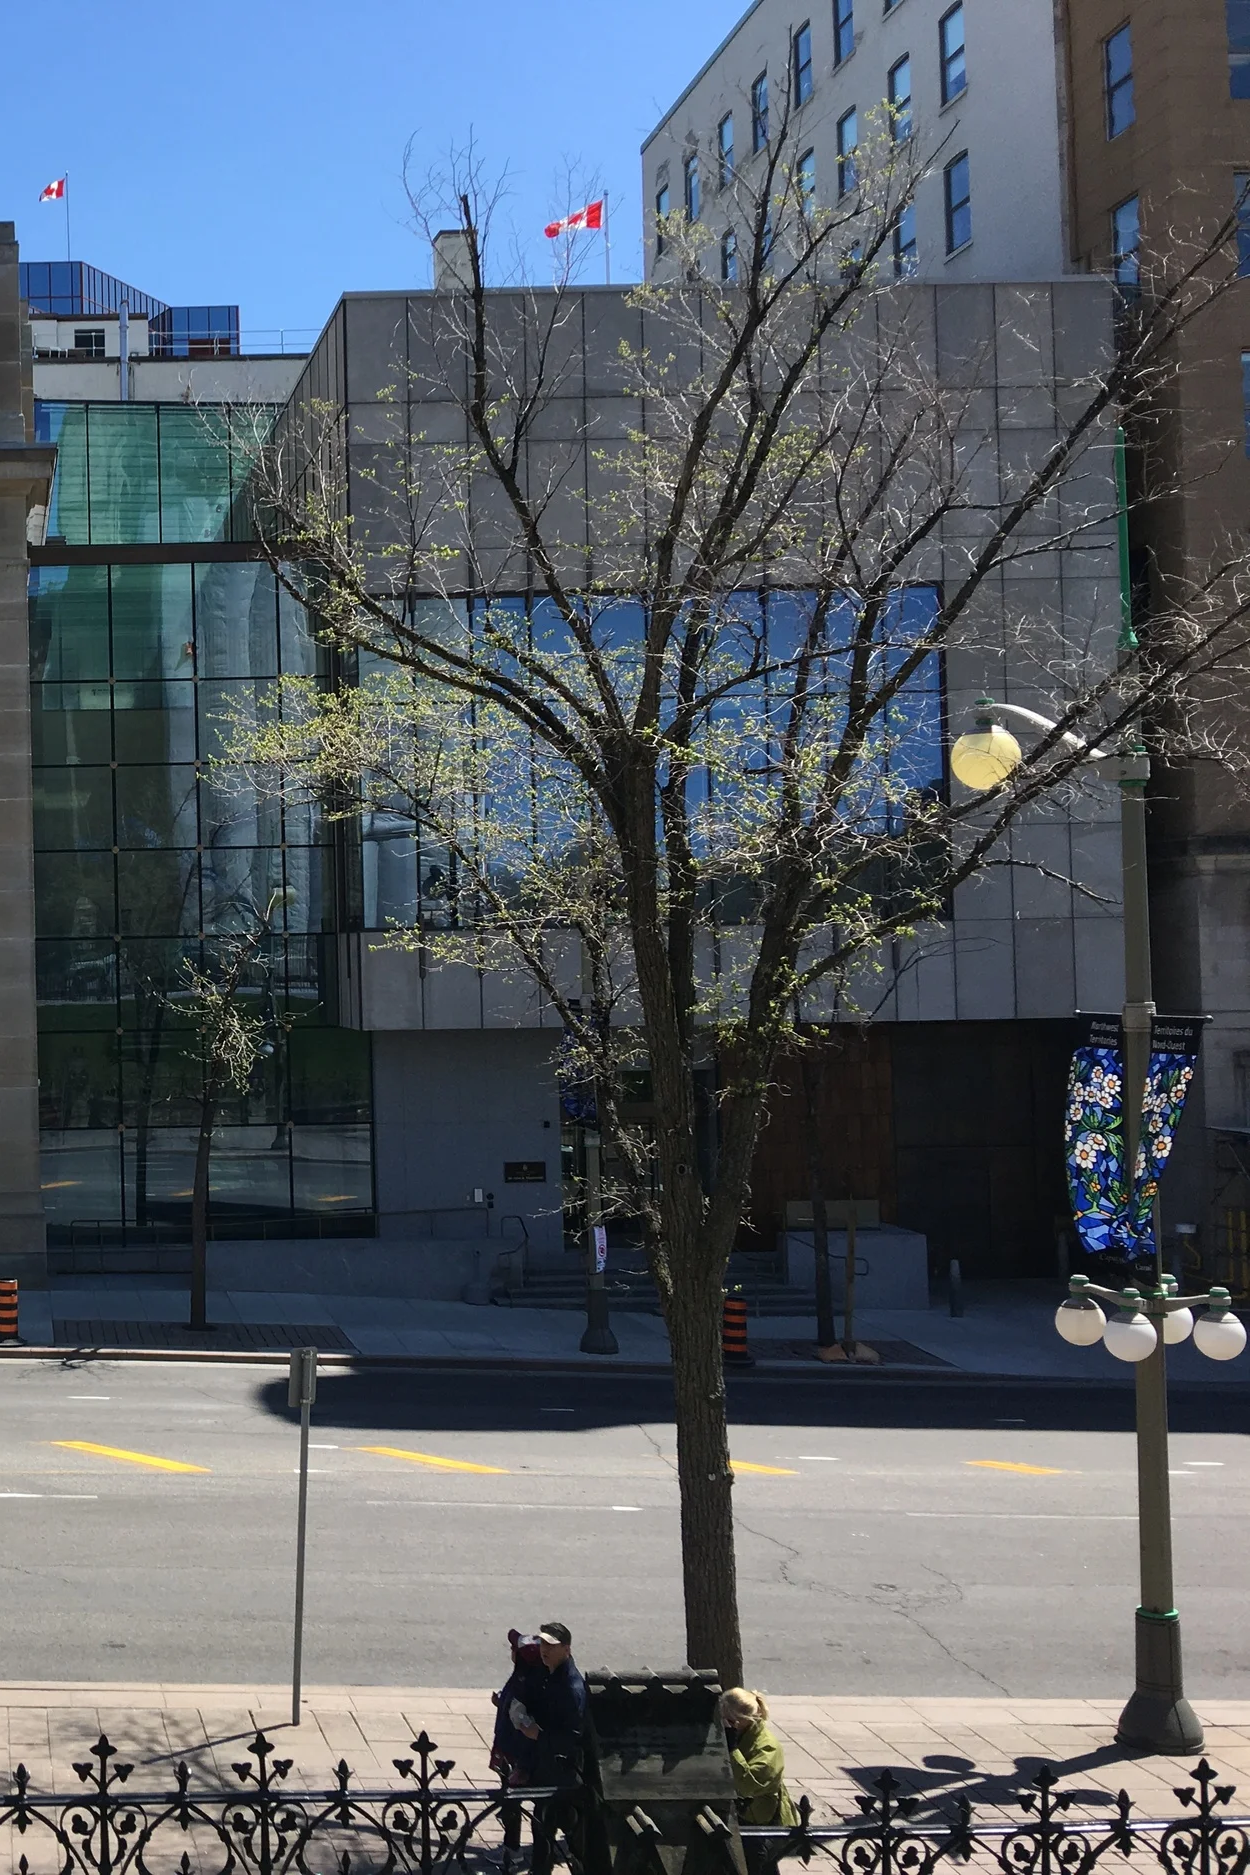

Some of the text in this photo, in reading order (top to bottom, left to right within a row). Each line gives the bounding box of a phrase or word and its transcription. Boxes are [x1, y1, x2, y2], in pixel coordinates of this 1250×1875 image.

[1153, 1025, 1193, 1036] Territoires du
[1090, 1034, 1118, 1046] Territories
[1152, 1040, 1185, 1050] Nord-Ouest
